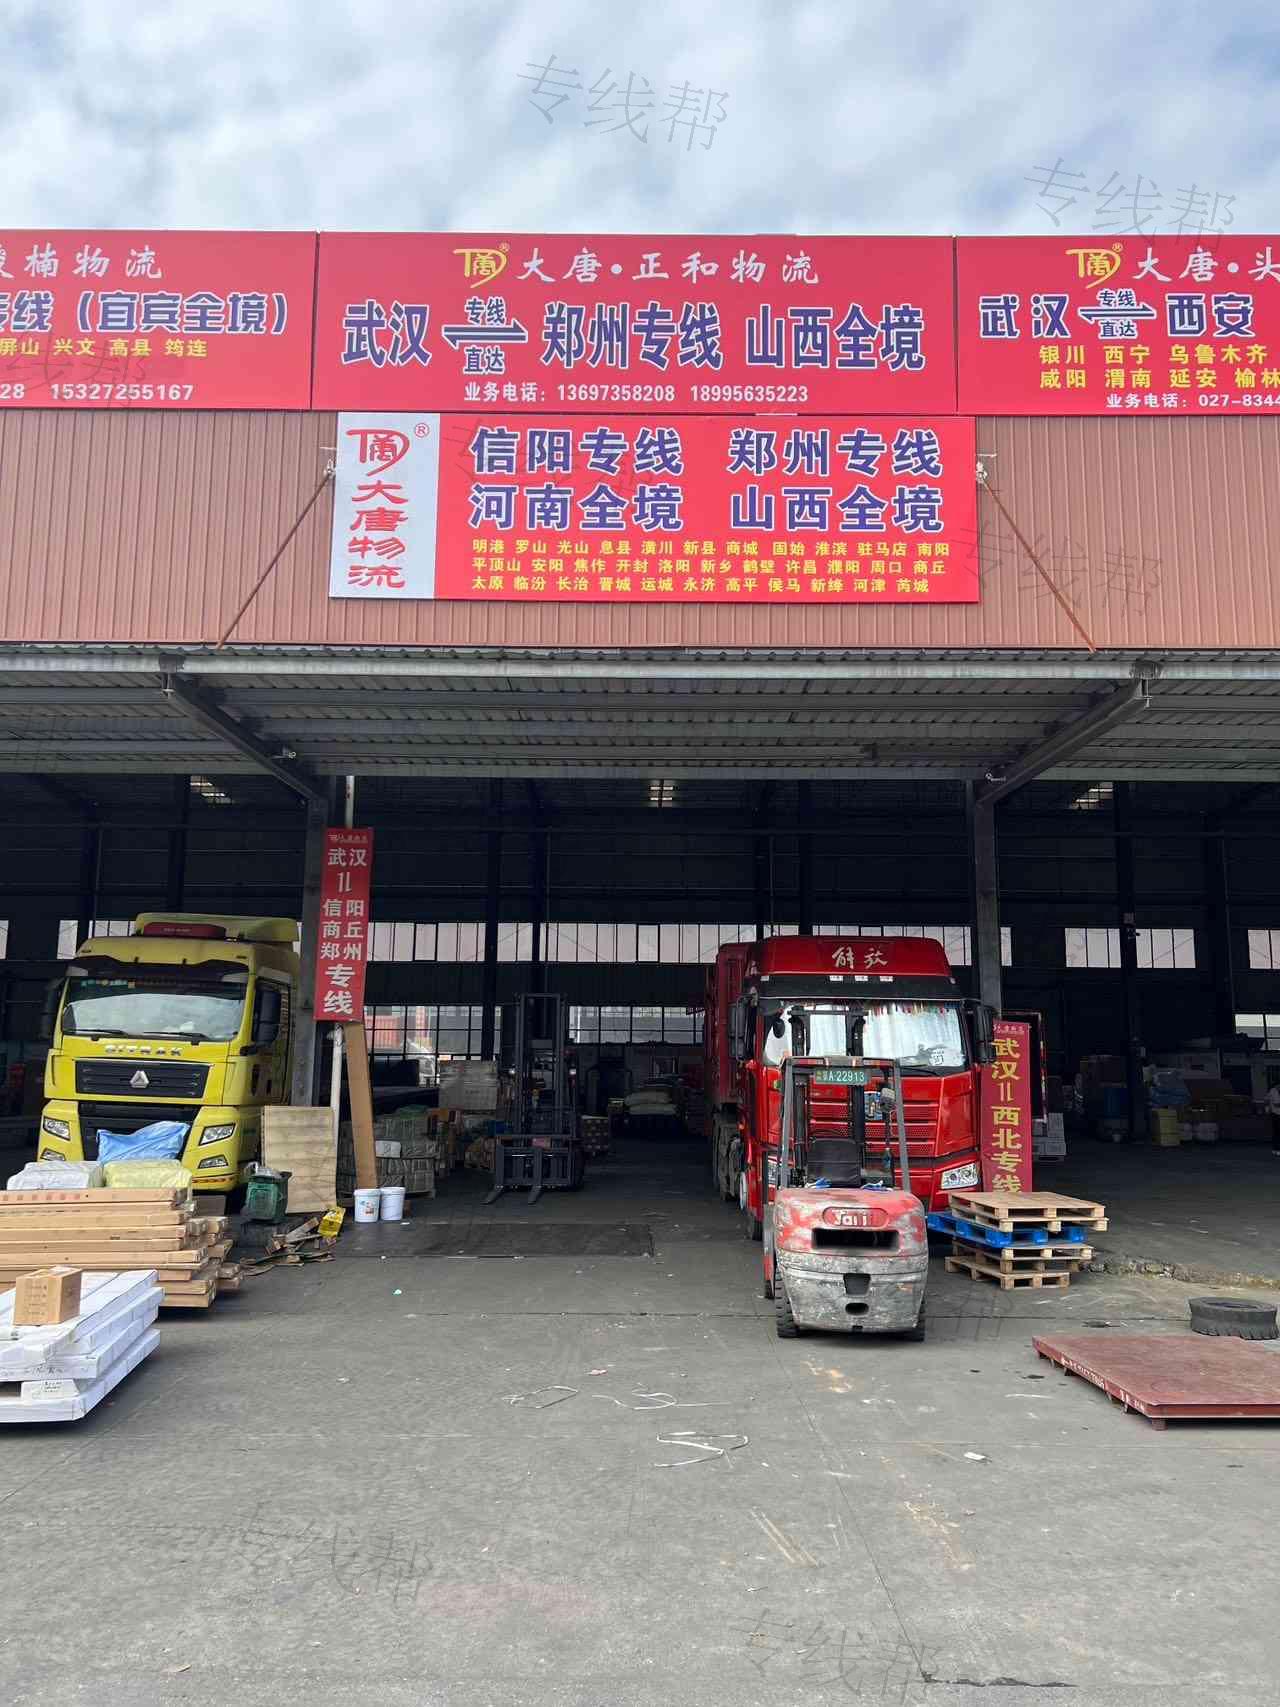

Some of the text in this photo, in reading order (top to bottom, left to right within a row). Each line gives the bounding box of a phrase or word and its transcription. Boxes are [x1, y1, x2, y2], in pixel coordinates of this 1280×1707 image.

[1097, 288, 1136, 308] 专线
[464, 297, 506, 325] 专线
[979, 291, 1256, 339] 武汉 西安
[341, 299, 926, 371] 武汉 郑州专线 山西全境
[1098, 320, 1137, 339] 直达
[53, 338, 96, 357] 兴文
[109, 338, 152, 358] 高县
[165, 339, 208, 358] 筠连
[1039, 344, 1267, 365] 银川 西宁 乌鲁木齐
[463, 345, 505, 374] 直达
[1039, 368, 1280, 389] 咸阳 渭南 延安 榆林
[51, 384, 194, 401] 15327255167
[558, 384, 675, 402] 13697358208
[690, 384, 808, 402] 18995635223
[468, 426, 683, 476] 信阳专线
[727, 428, 943, 478] 郑州专线
[468, 483, 944, 534] 河南全境 山西全境
[347, 480, 408, 589] 大唐物流
[515, 539, 547, 554] 罗山
[557, 540, 589, 554] 光山
[683, 541, 716, 555] 新县
[726, 541, 758, 555] 商城
[772, 541, 805, 556] 固始
[857, 542, 907, 556] 驻马店
[917, 542, 949, 556] 南阳
[472, 557, 521, 572] 平顶山
[531, 558, 564, 572] 安阳
[574, 559, 606, 573] 焦作
[616, 559, 648, 573] 开封
[658, 559, 690, 573] 洛阳
[701, 559, 732, 573] 新乡
[786, 560, 817, 574] 许昌
[870, 560, 902, 574] 周口
[913, 561, 946, 575] 商丘
[472, 576, 504, 590] 太原
[514, 576, 546, 591] 临汾
[557, 576, 589, 591] 长治
[641, 577, 674, 592] 运城
[683, 577, 715, 592] 永济
[726, 577, 758, 592] 高平
[328, 848, 367, 867] 武汉
[322, 899, 364, 917] 信阳
[322, 920, 364, 939] 商丘
[320, 943, 362, 961] 郑州
[323, 963, 355, 1015] 专线
[991, 1038, 1021, 1081] 武汉
[991, 1106, 1023, 1192] 西北专线
